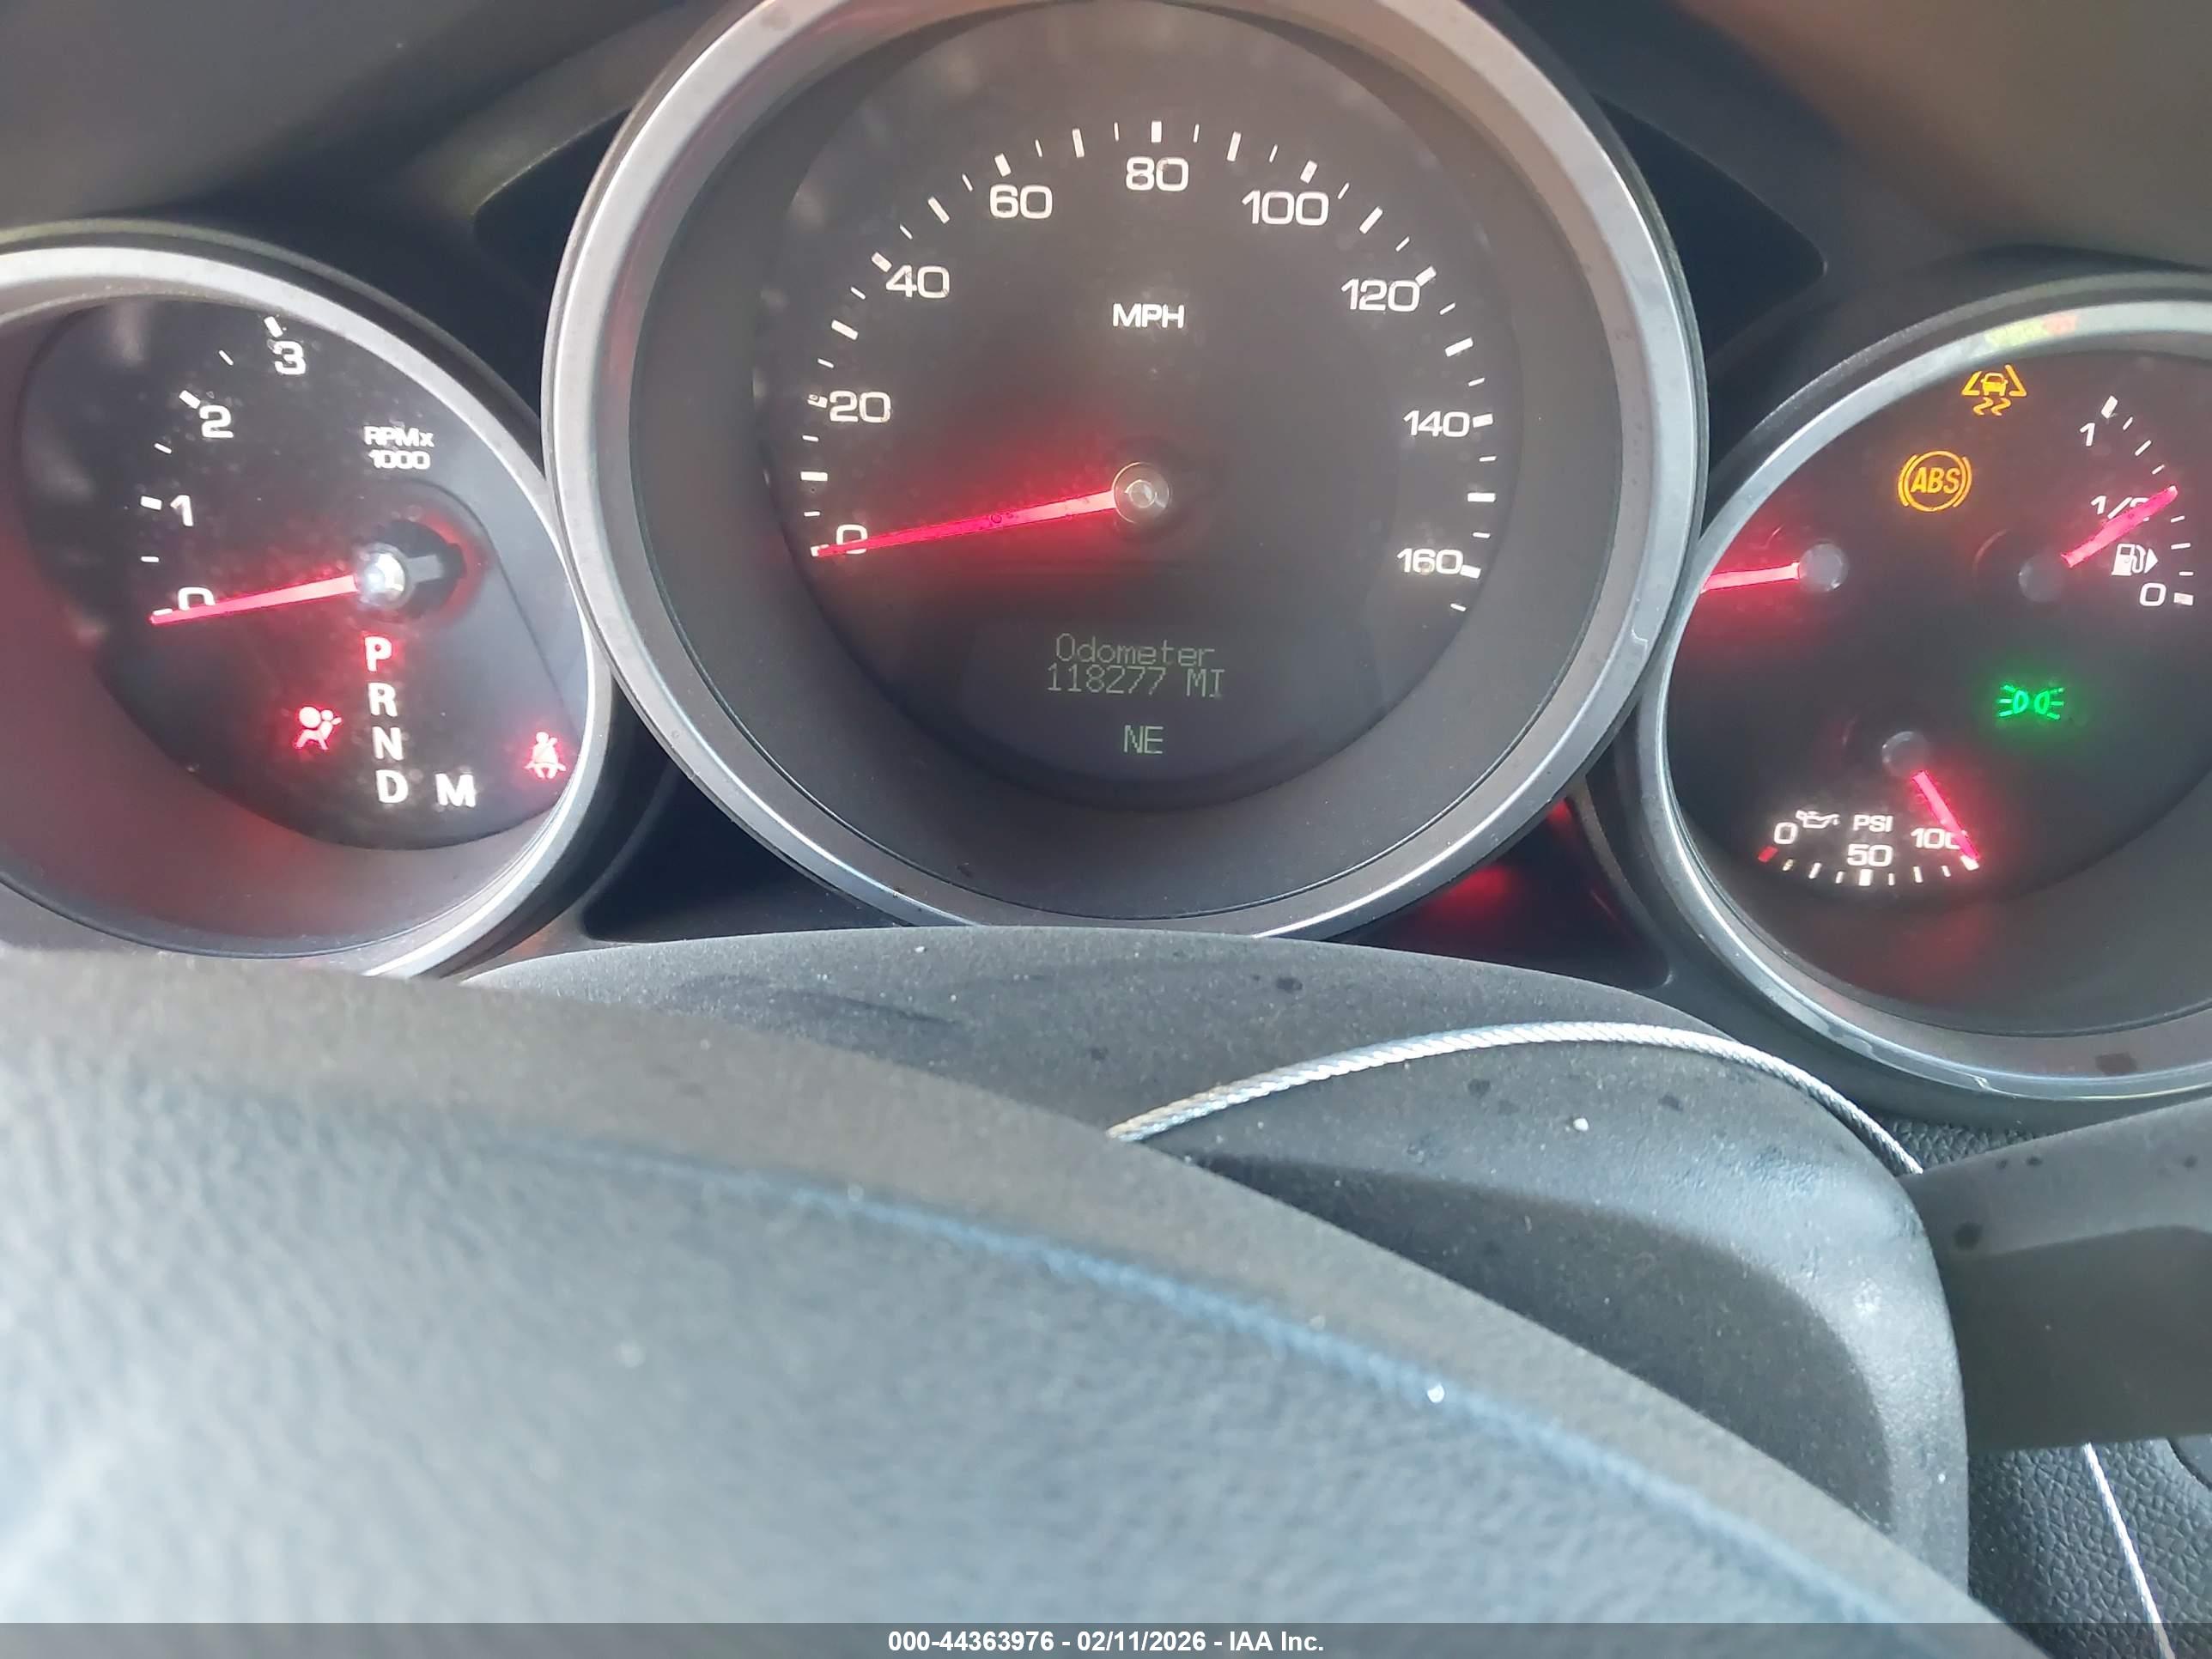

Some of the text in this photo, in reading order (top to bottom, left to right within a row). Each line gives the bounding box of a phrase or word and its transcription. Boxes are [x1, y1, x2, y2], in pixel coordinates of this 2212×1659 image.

[1126, 156, 1189, 191] 80
[989, 185, 1053, 219] 60
[1242, 191, 1329, 226] 100
[885, 264, 951, 299] 40
[1341, 278, 1420, 312] 120
[1113, 303, 1185, 328] MPH
[273, 341, 306, 375] 3
[199, 405, 234, 439] 2
[829, 391, 891, 423] 20
[364, 426, 434, 447] RPMx
[1403, 410, 1470, 437] 140
[2079, 422, 2096, 447] 1
[369, 450, 431, 470] 1000
[1911, 466, 1961, 495] ABS
[170, 495, 194, 526] 1
[836, 524, 868, 554] 0
[1397, 548, 1464, 575] 160
[2139, 582, 2166, 606] 0
[365, 635, 392, 672] P
[1055, 633, 1215, 667] Odometer
[1047, 663, 1225, 697] 118277 MI
[368, 683, 398, 717] R
[373, 726, 404, 761] N
[1124, 725, 1164, 754] NE
[375, 769, 477, 807] D M
[1774, 822, 1798, 844] 0
[1853, 814, 1893, 833] PSI
[1846, 843, 1893, 867] 50
